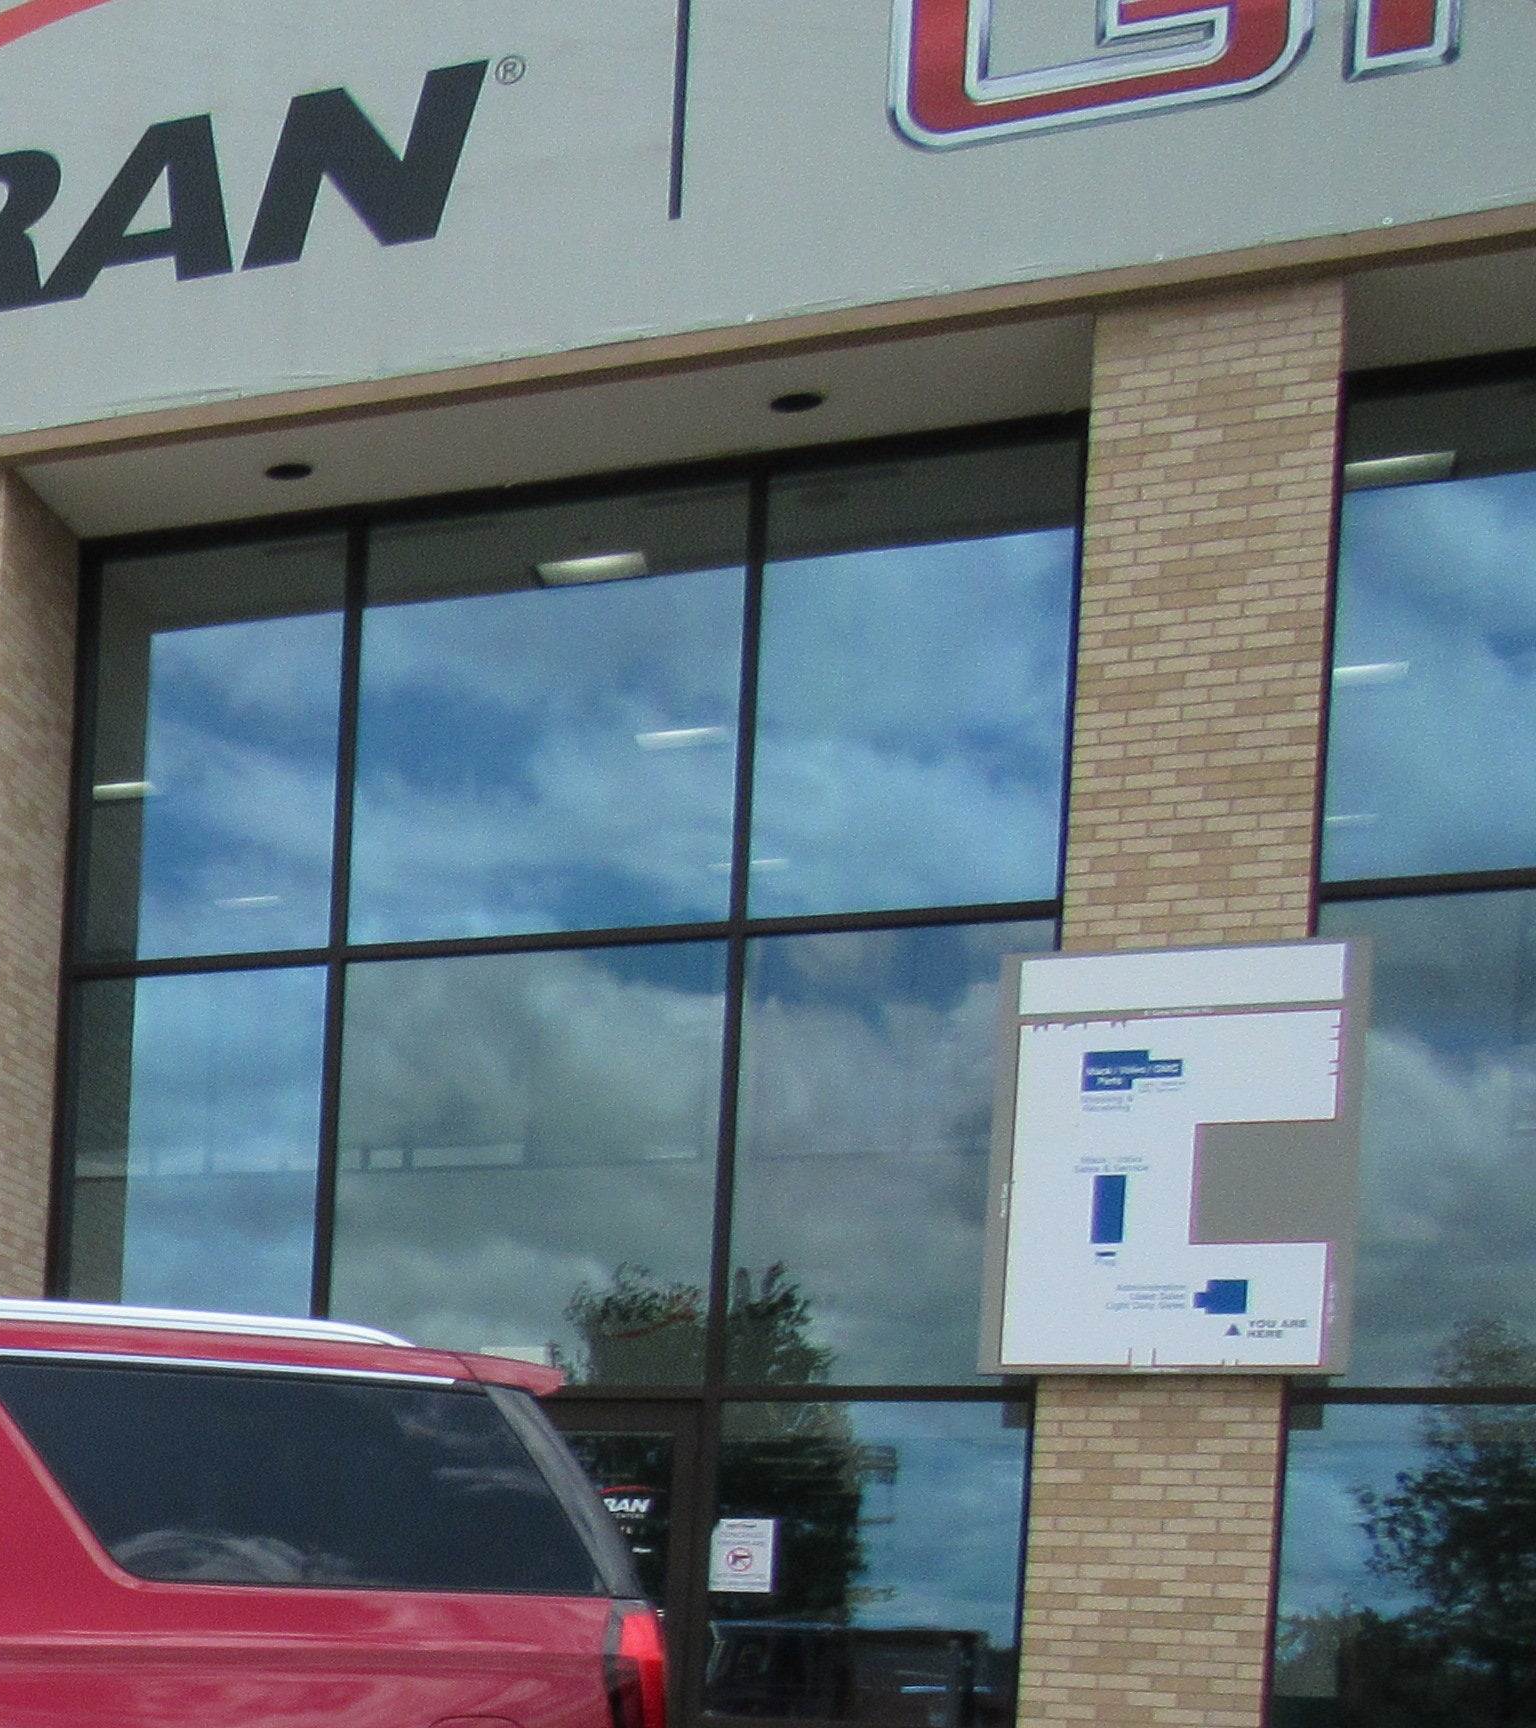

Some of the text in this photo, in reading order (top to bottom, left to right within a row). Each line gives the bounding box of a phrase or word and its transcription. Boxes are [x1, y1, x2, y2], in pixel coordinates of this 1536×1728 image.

[1248, 1318, 1308, 1329] YOU ARE
[1246, 1329, 1283, 1338] HERE
